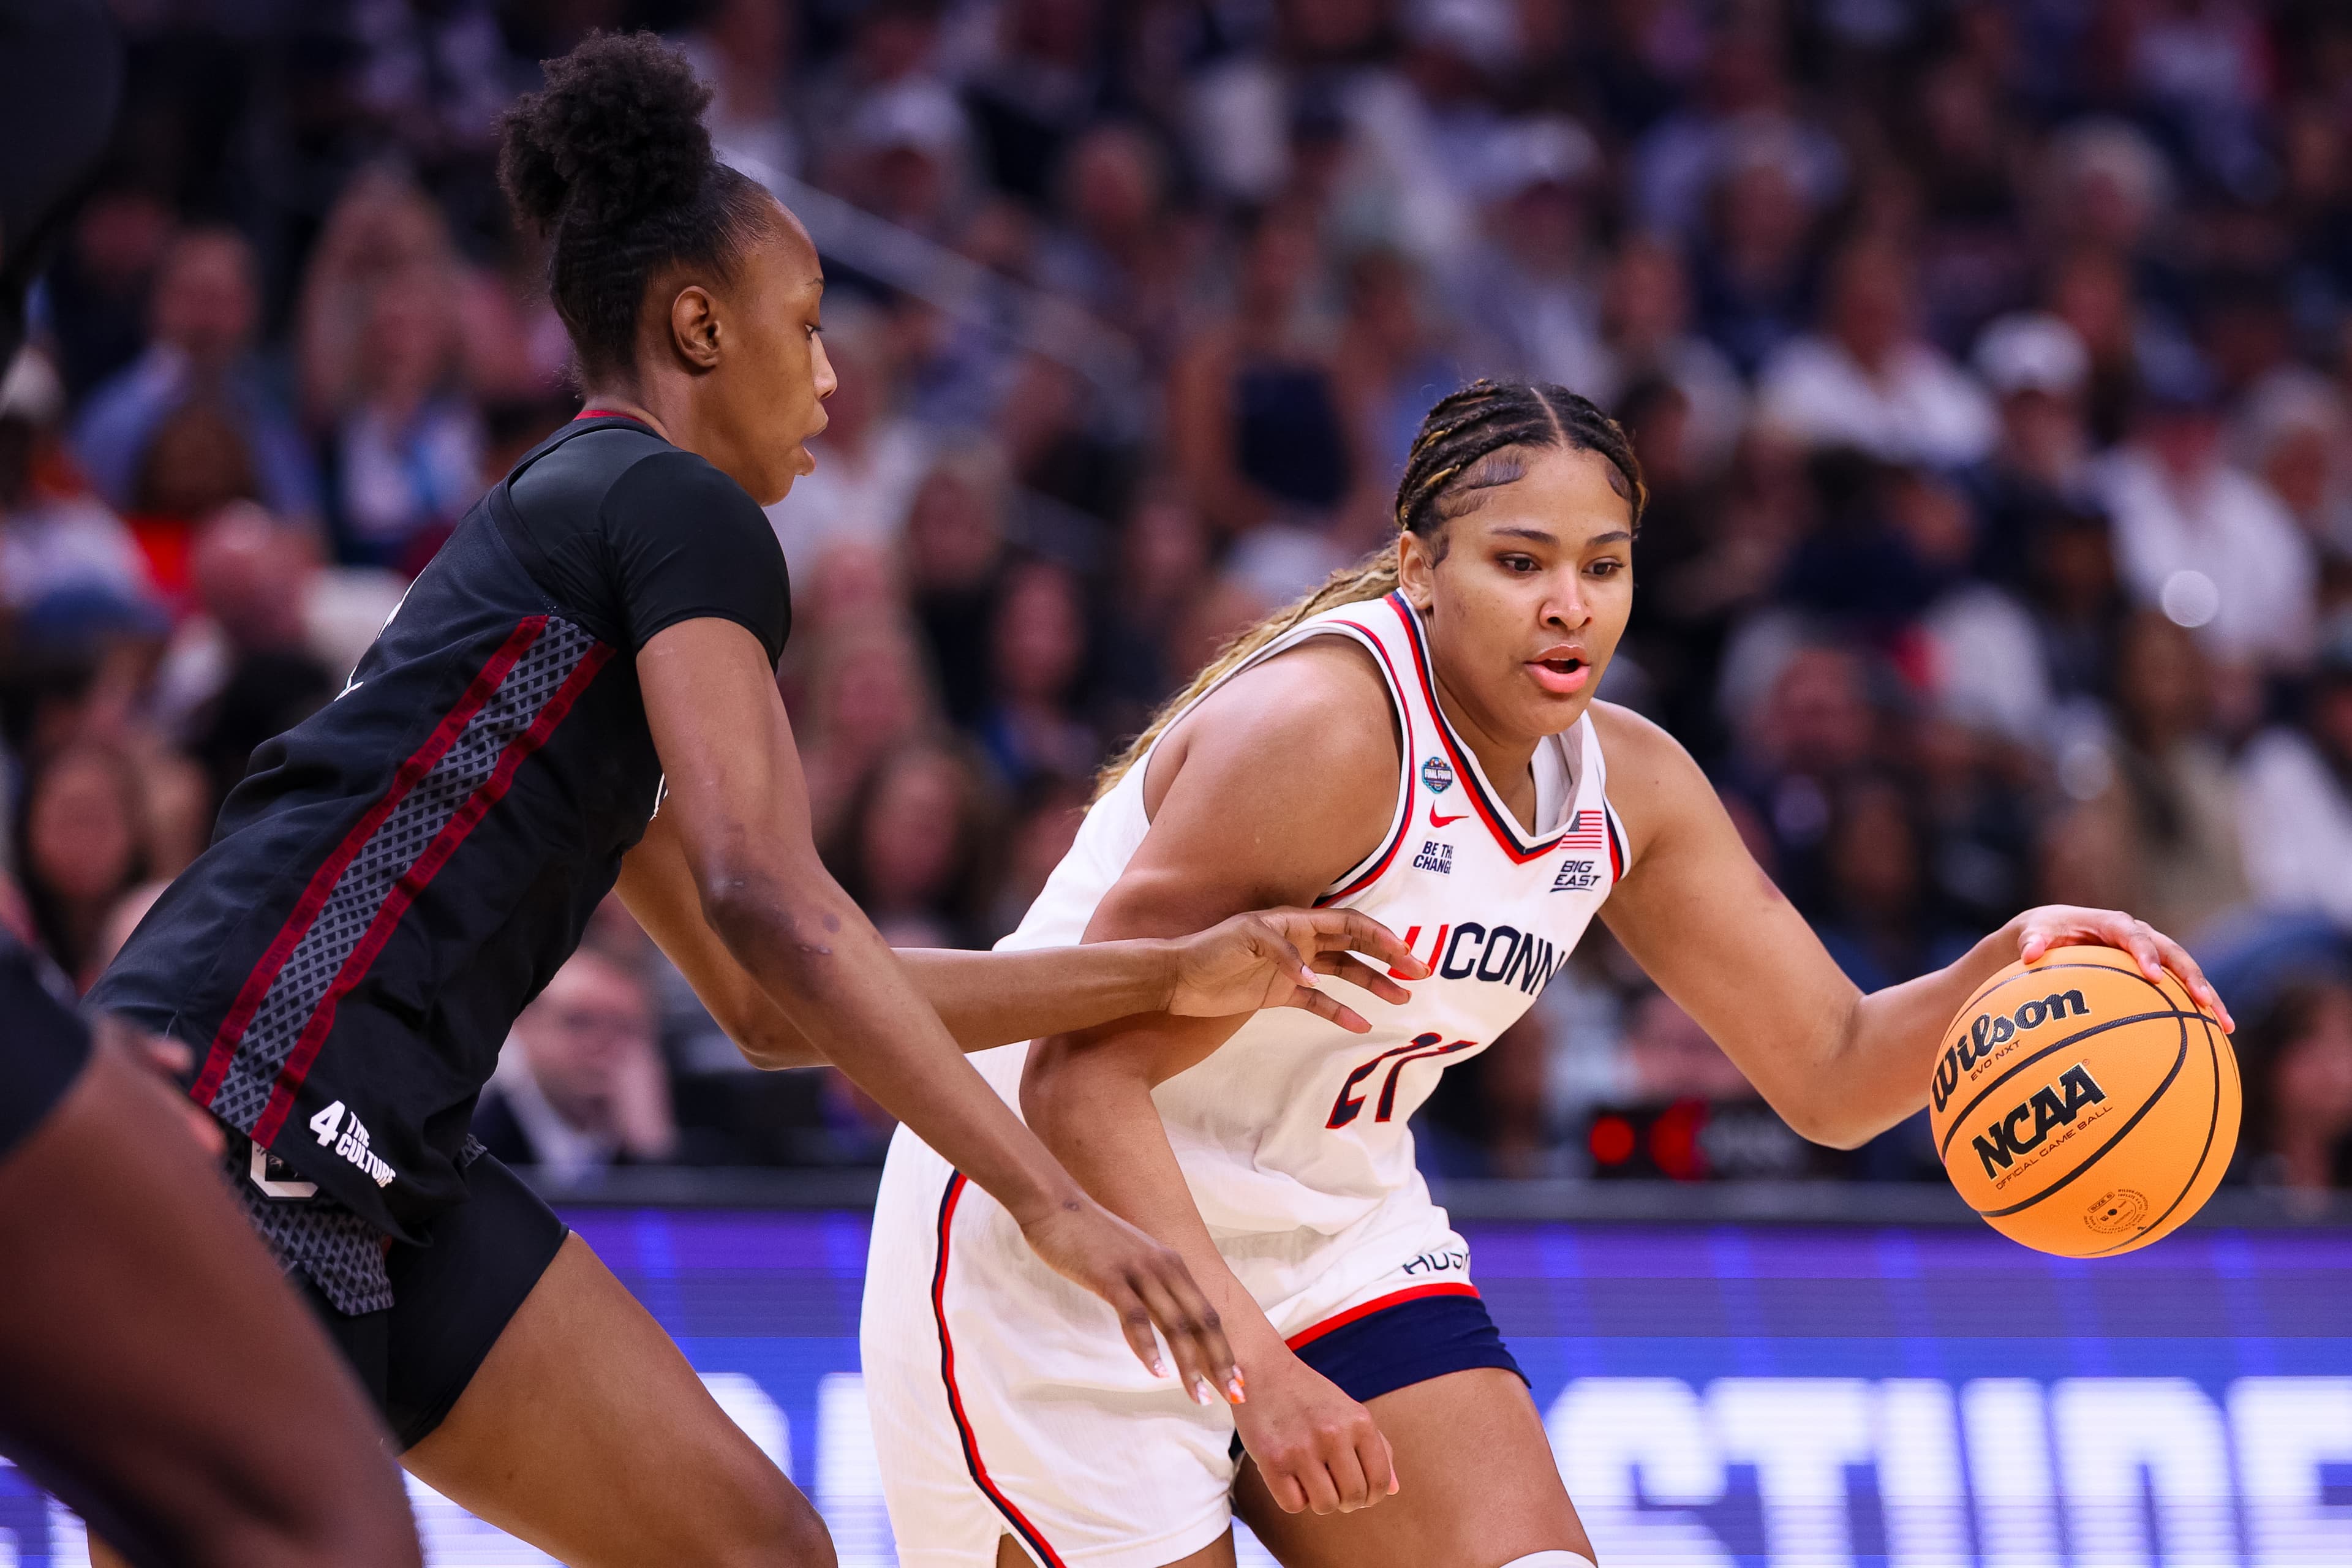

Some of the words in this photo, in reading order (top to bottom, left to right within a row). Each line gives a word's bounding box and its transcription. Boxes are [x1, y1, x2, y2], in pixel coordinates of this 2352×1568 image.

[1422, 841, 1439, 856] BE
[1560, 861, 1594, 873] BIG
[1554, 875, 1601, 887] EAST
[1387, 922, 1566, 995] UCONN
[1932, 989, 2090, 1114] Wilson
[1971, 1060, 1992, 1082] EVO
[1995, 1040, 2020, 1060] NXT
[1325, 1032, 1478, 1129] 21
[309, 1100, 345, 1147] 4
[347, 1111, 370, 1148] THE
[1972, 1062, 2108, 1180] NCAA
[1996, 1158, 2039, 1190] OFFICIAL
[2039, 1129, 2076, 1157] GAME
[2077, 1107, 2113, 1131] BALL
[1403, 1252, 1470, 1275] HUS
